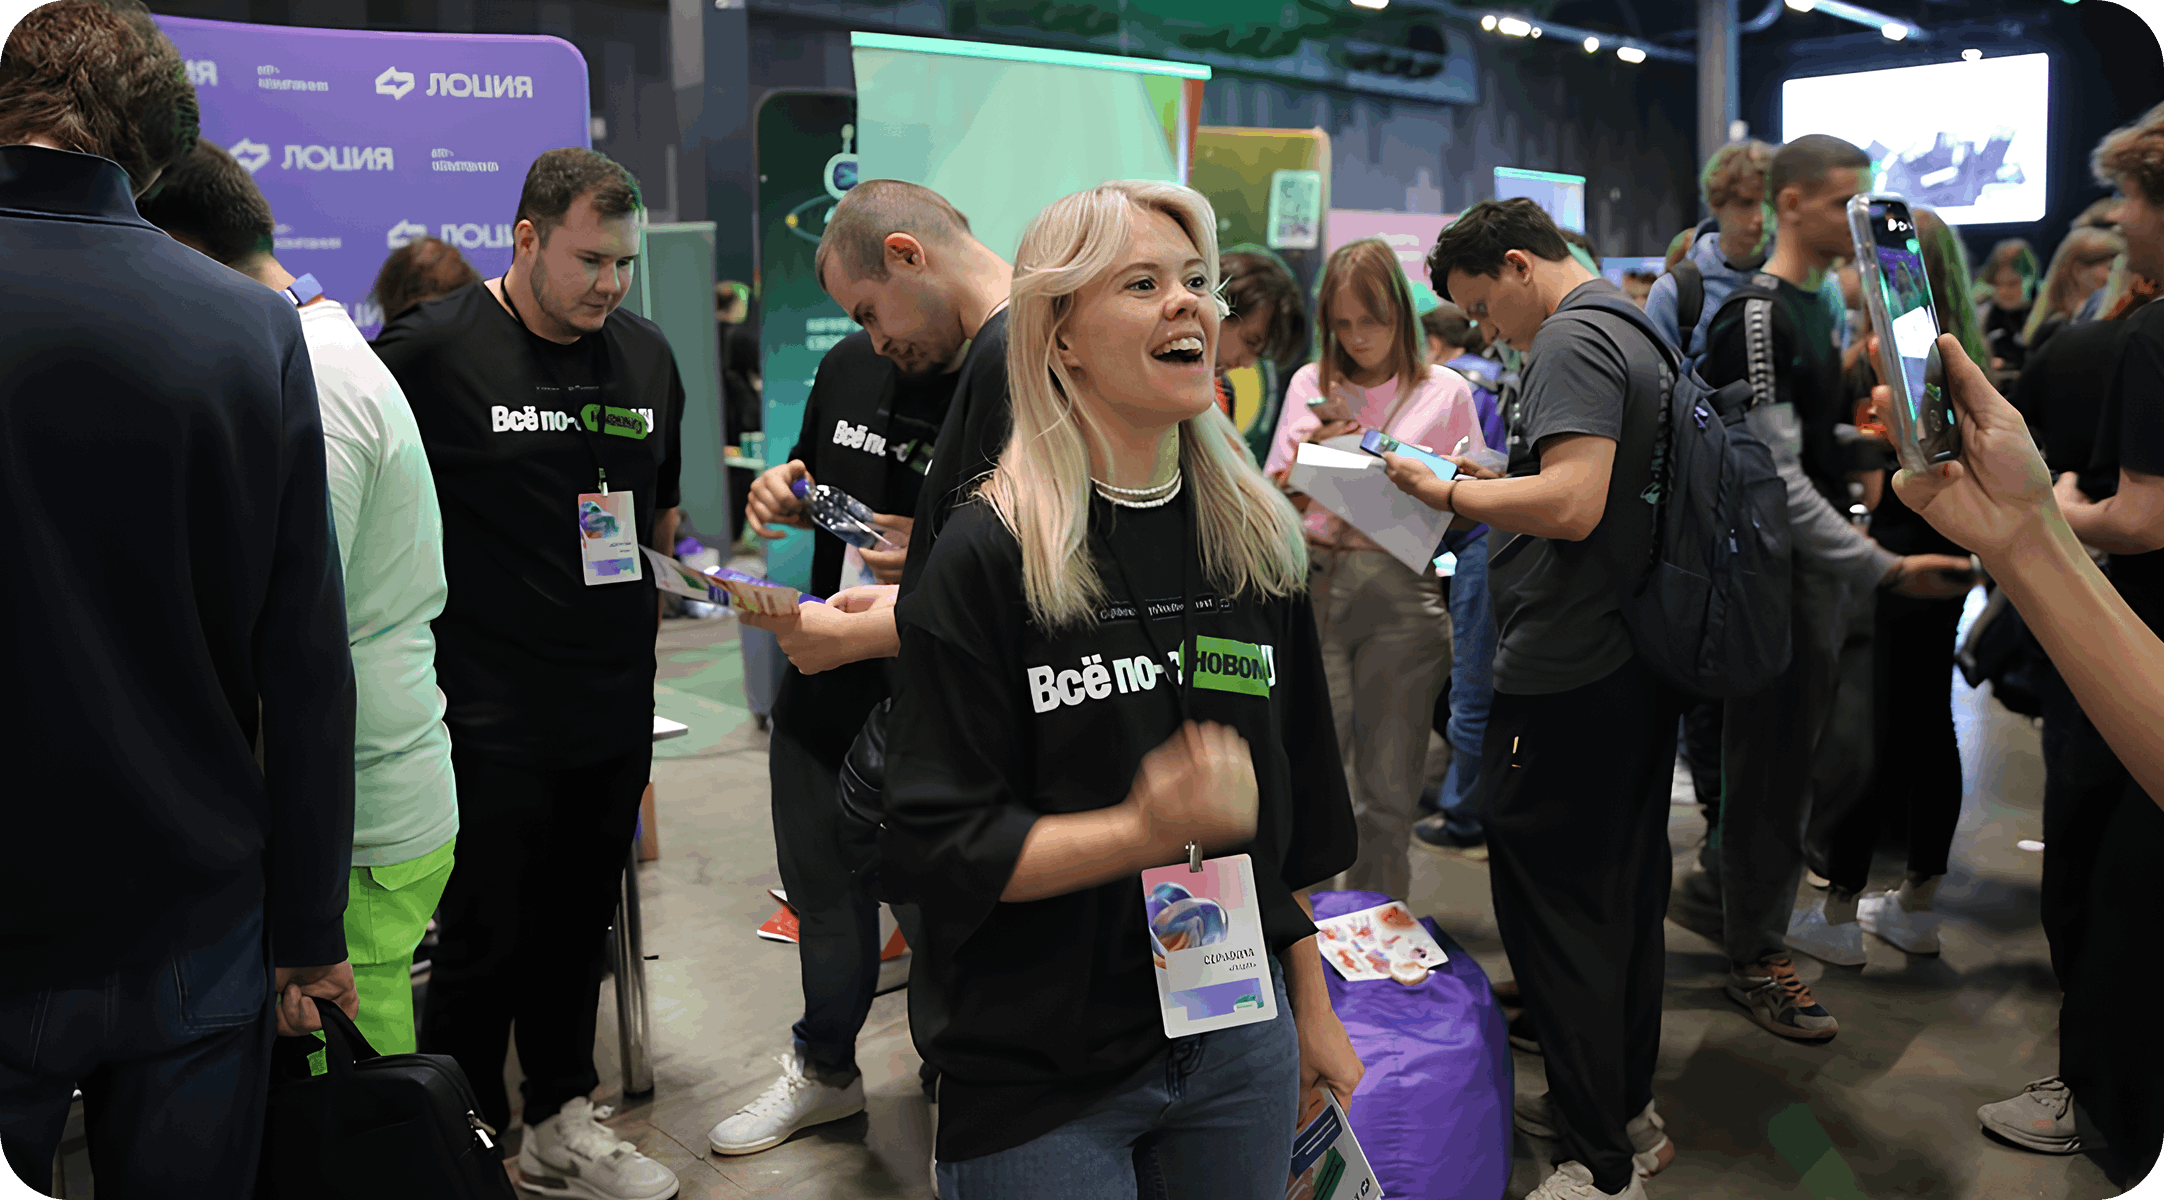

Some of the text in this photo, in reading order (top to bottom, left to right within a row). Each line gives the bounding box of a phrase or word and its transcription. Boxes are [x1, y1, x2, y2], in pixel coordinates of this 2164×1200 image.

[426, 73, 533, 98] ЛОЦИЯ
[281, 145, 394, 171] ЛОЦИЯ
[491, 405, 539, 432] Всё
[1027, 654, 1112, 713] Всё
